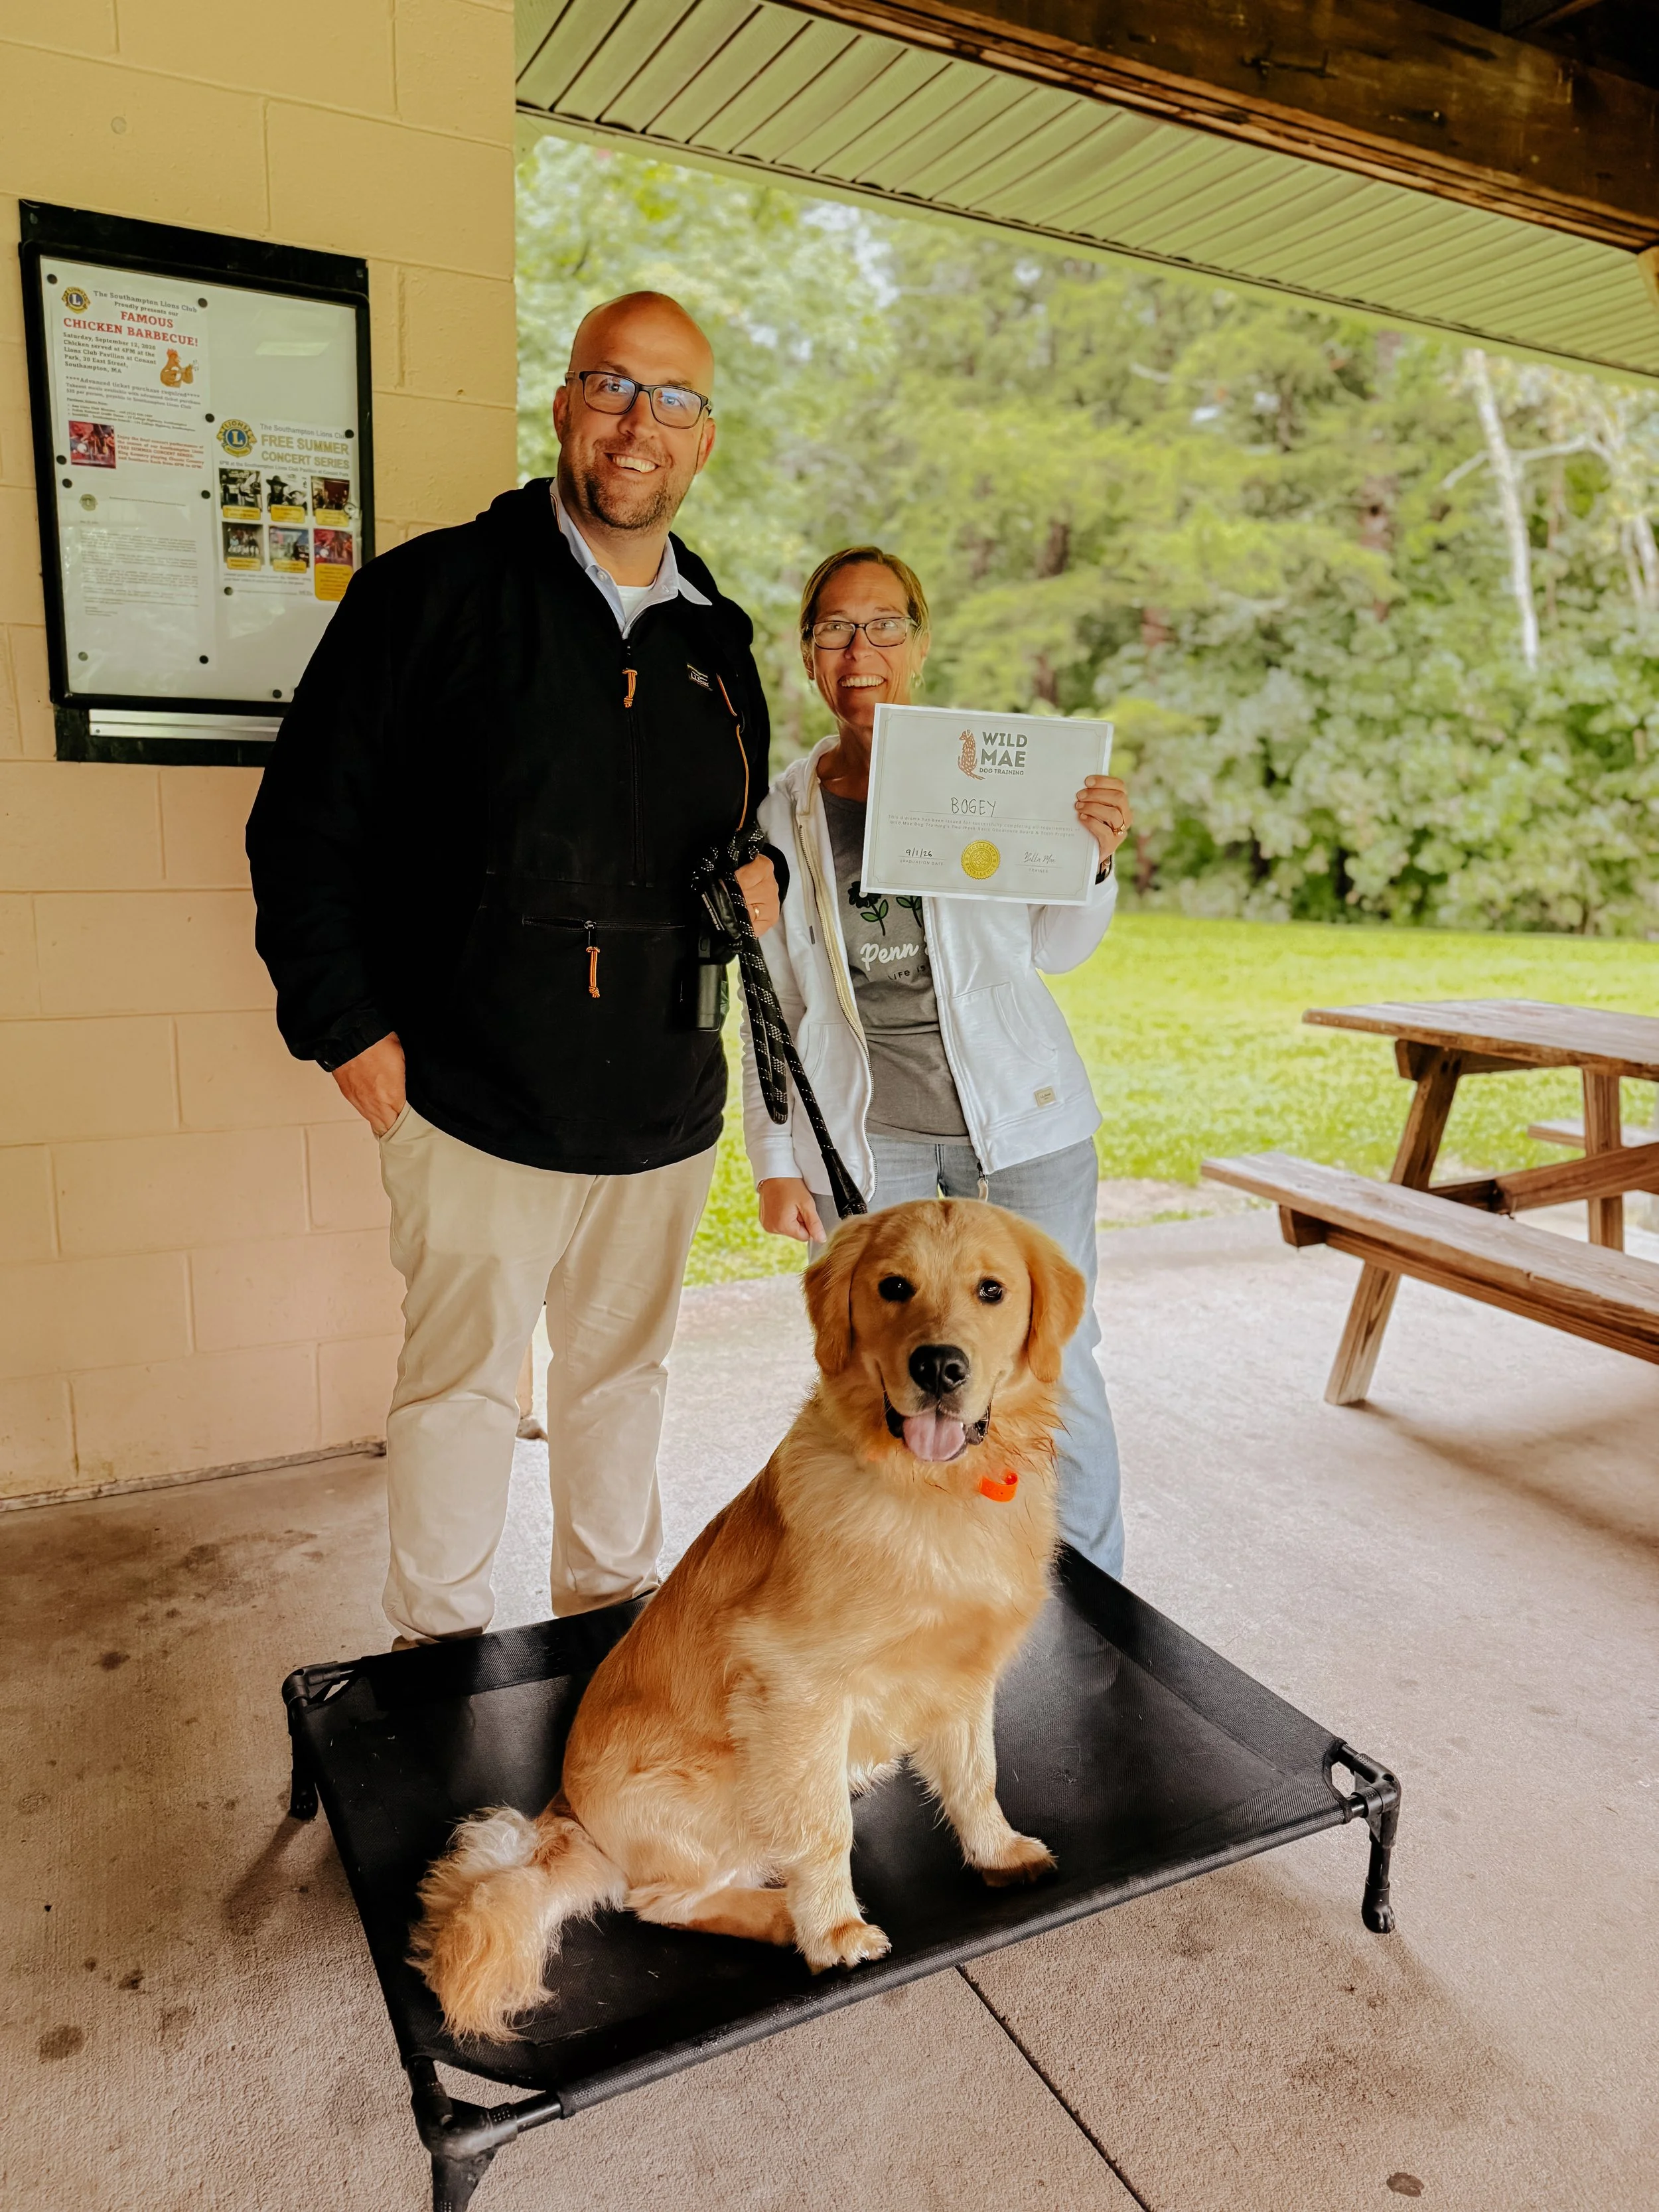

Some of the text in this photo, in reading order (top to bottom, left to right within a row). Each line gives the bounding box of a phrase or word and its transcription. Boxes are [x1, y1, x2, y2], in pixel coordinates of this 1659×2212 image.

[110, 293, 158, 305] Southampton
[161, 301, 179, 309] Lions
[115, 301, 138, 311] Proudly
[121, 311, 173, 328] FAMOUS
[64, 318, 198, 346] CHICKEN BARBECUE!
[64, 332, 93, 341] Saturday,
[100, 351, 124, 360] Pavilion
[65, 362, 109, 372] Southampton,
[223, 421, 248, 429] LIONS
[274, 425, 315, 435] Southampton
[261, 434, 349, 455] FREE SUMMER
[261, 451, 311, 465] CONCERT
[314, 457, 350, 469] SERIES
[982, 731, 1028, 747] WILD
[981, 749, 1026, 767] MAE
[951, 797, 996, 818] BOGEY
[906, 848, 932, 857] 9/1/26
[860, 943, 919, 971] Penn
